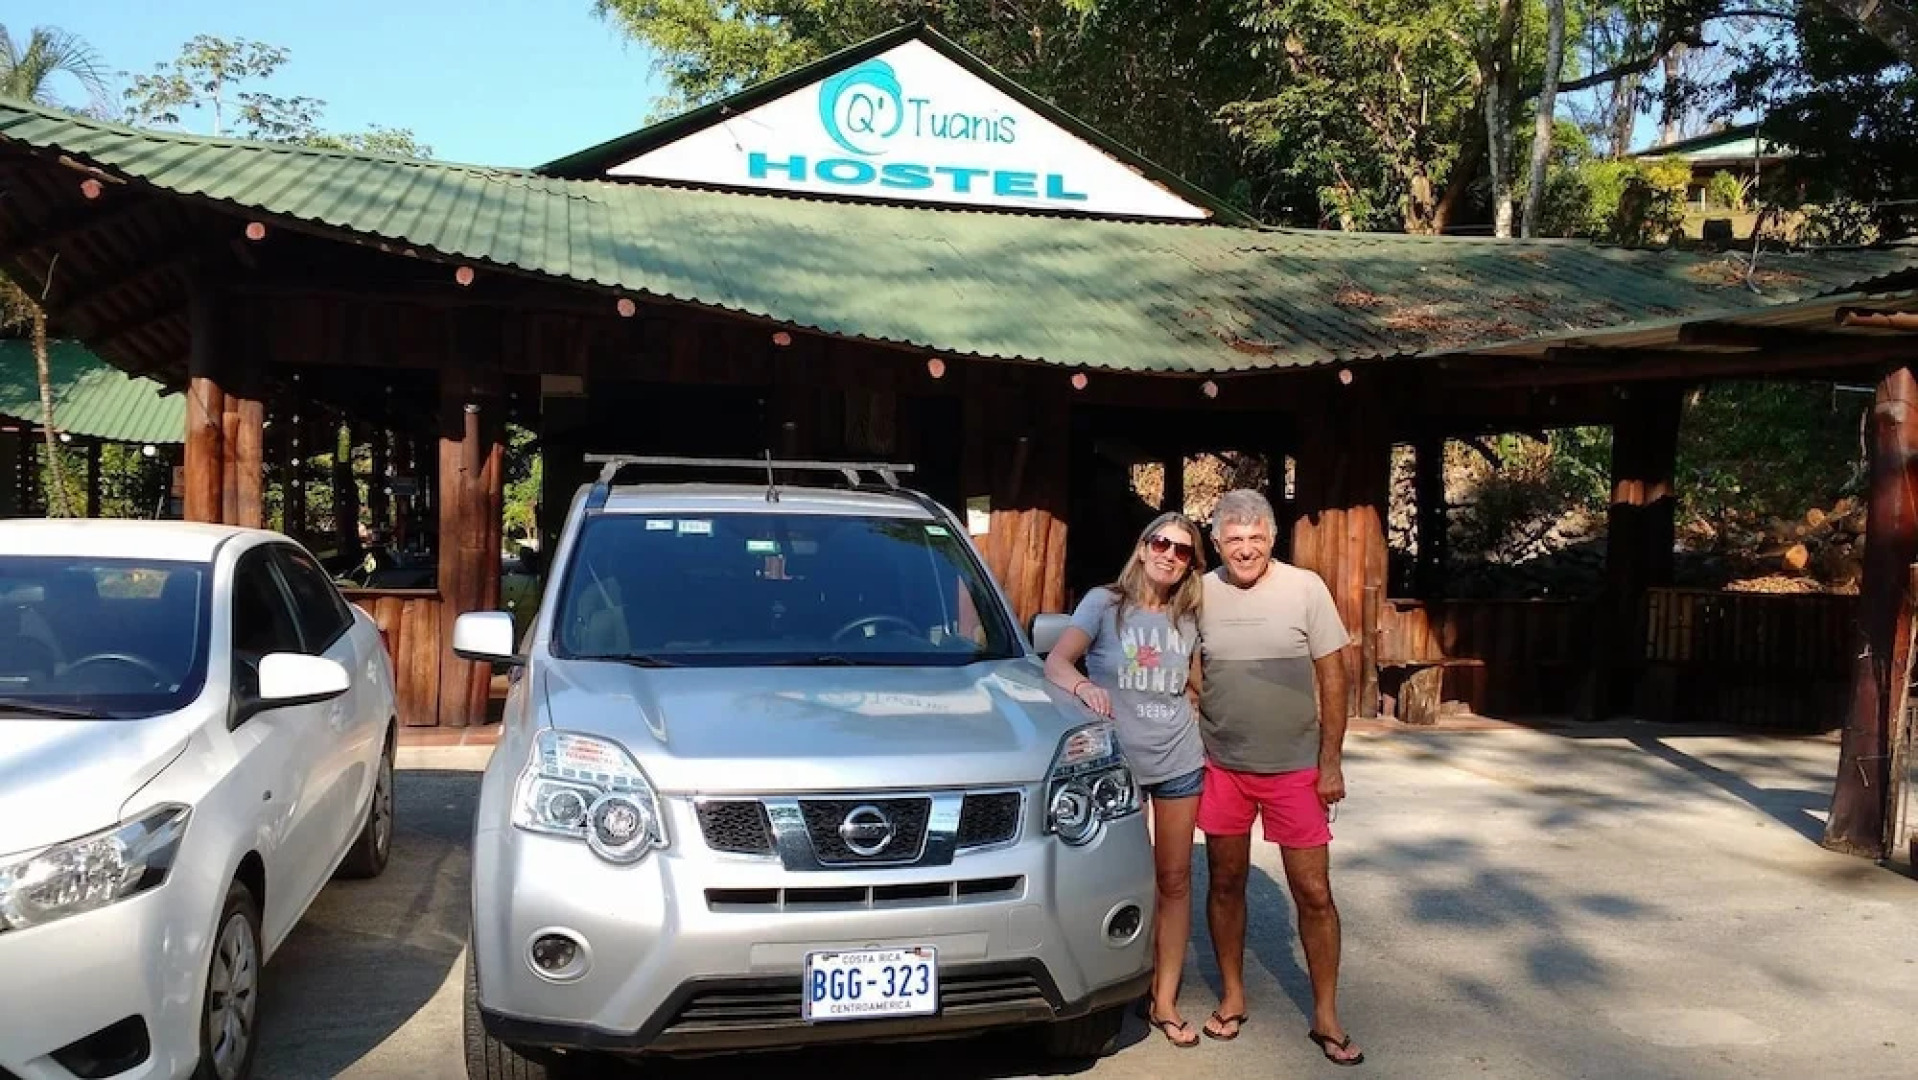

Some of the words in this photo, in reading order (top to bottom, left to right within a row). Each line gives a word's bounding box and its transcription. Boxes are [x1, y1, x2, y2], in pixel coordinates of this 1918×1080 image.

[909, 98, 1016, 144] Tuanis
[748, 151, 1088, 200] HOSTEL
[843, 954, 875, 964] COSTA
[880, 952, 901, 962] RICA
[813, 964, 929, 1002] BGG-323
[831, 1001, 911, 1013] CENTROAMERICA
